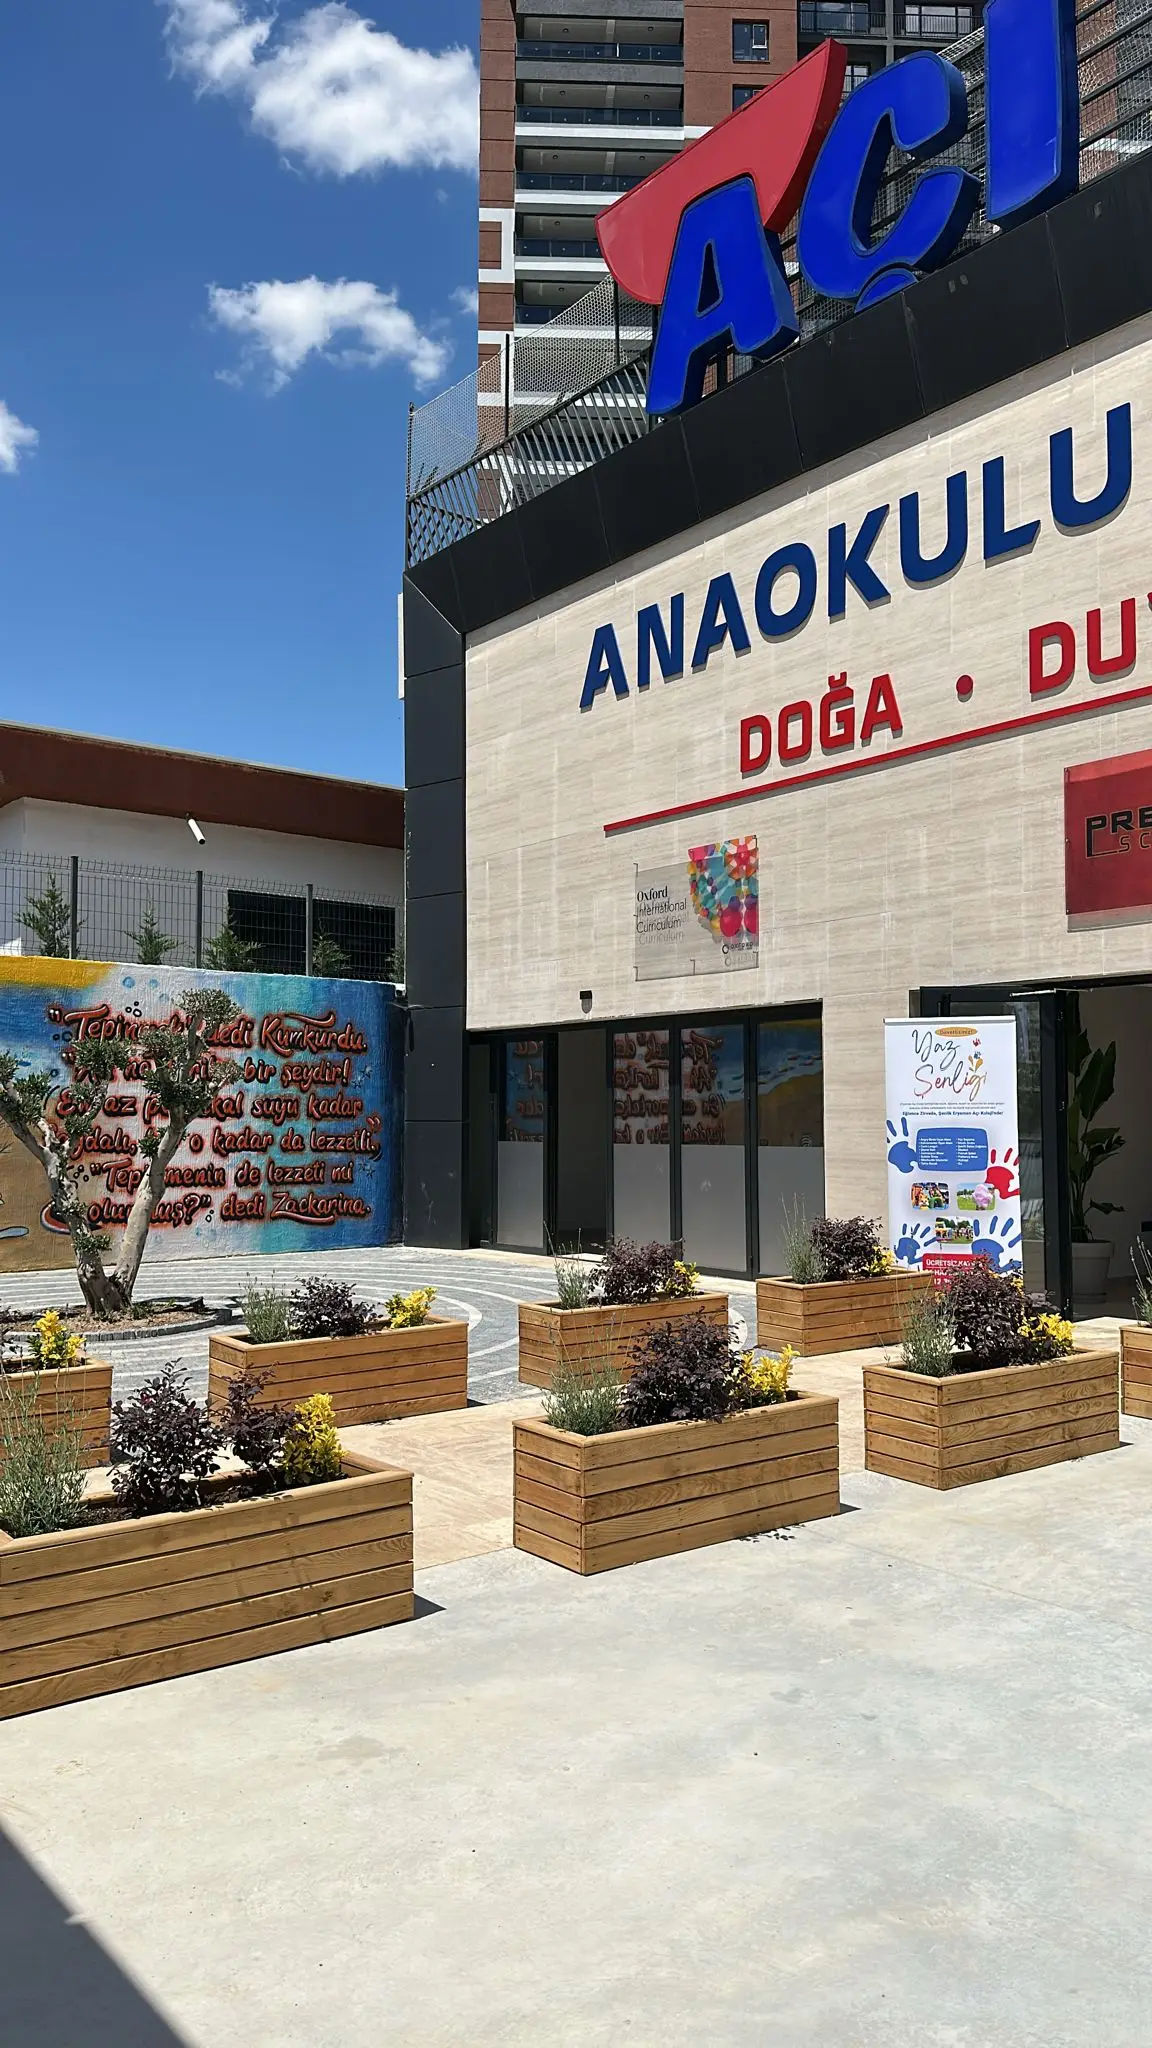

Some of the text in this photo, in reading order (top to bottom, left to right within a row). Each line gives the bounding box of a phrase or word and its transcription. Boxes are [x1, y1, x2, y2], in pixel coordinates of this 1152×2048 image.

[579, 403, 1131, 712] ANAOKULU
[740, 594, 1152, 774] DOĞA DU
[636, 885, 668, 902] Oxford
[637, 897, 687, 917] International
[636, 918, 682, 934] Curriculum
[911, 1029, 961, 1071] Yaz
[243, 1056, 277, 1083] bir
[280, 1057, 351, 1093] şeydir!
[102, 1095, 138, 1117] az
[251, 1095, 299, 1126] suyu
[307, 1091, 363, 1120] kadar
[189, 1133, 205, 1152] o
[212, 1126, 274, 1157] kadar
[280, 1127, 305, 1151] da
[234, 1159, 261, 1186] de
[267, 1159, 326, 1185] lezzeti
[331, 1161, 354, 1183] mi
[220, 1193, 265, 1221] dedi
[270, 1192, 372, 1225] Zackarina.
